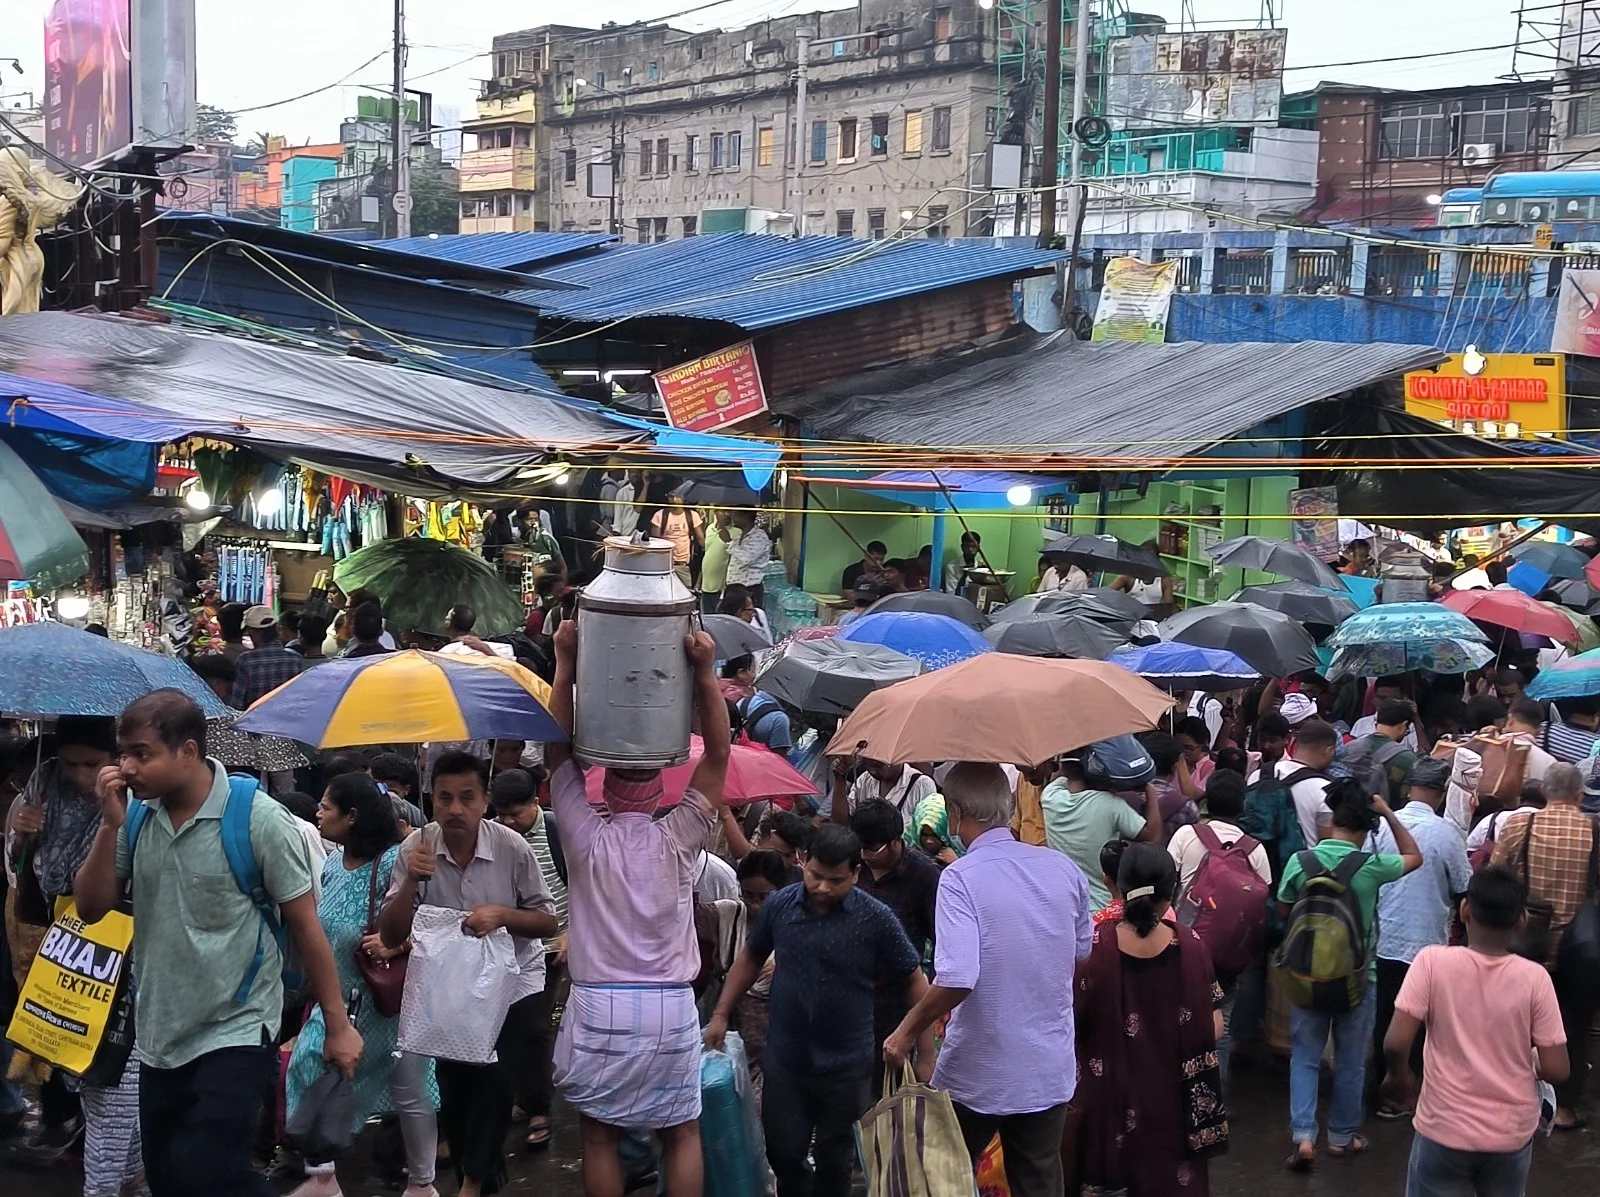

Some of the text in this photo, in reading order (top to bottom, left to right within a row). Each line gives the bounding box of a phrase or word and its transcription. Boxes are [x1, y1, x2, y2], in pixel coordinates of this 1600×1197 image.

[668, 348, 743, 383] INDIAN BIRYANI
[667, 385, 693, 398] CHICKEN
[1411, 376, 1468, 399] KOLKATA
[1447, 402, 1510, 419] BIRYANI
[40, 926, 123, 984] BALAJI
[56, 971, 112, 1004] TEXTILE
